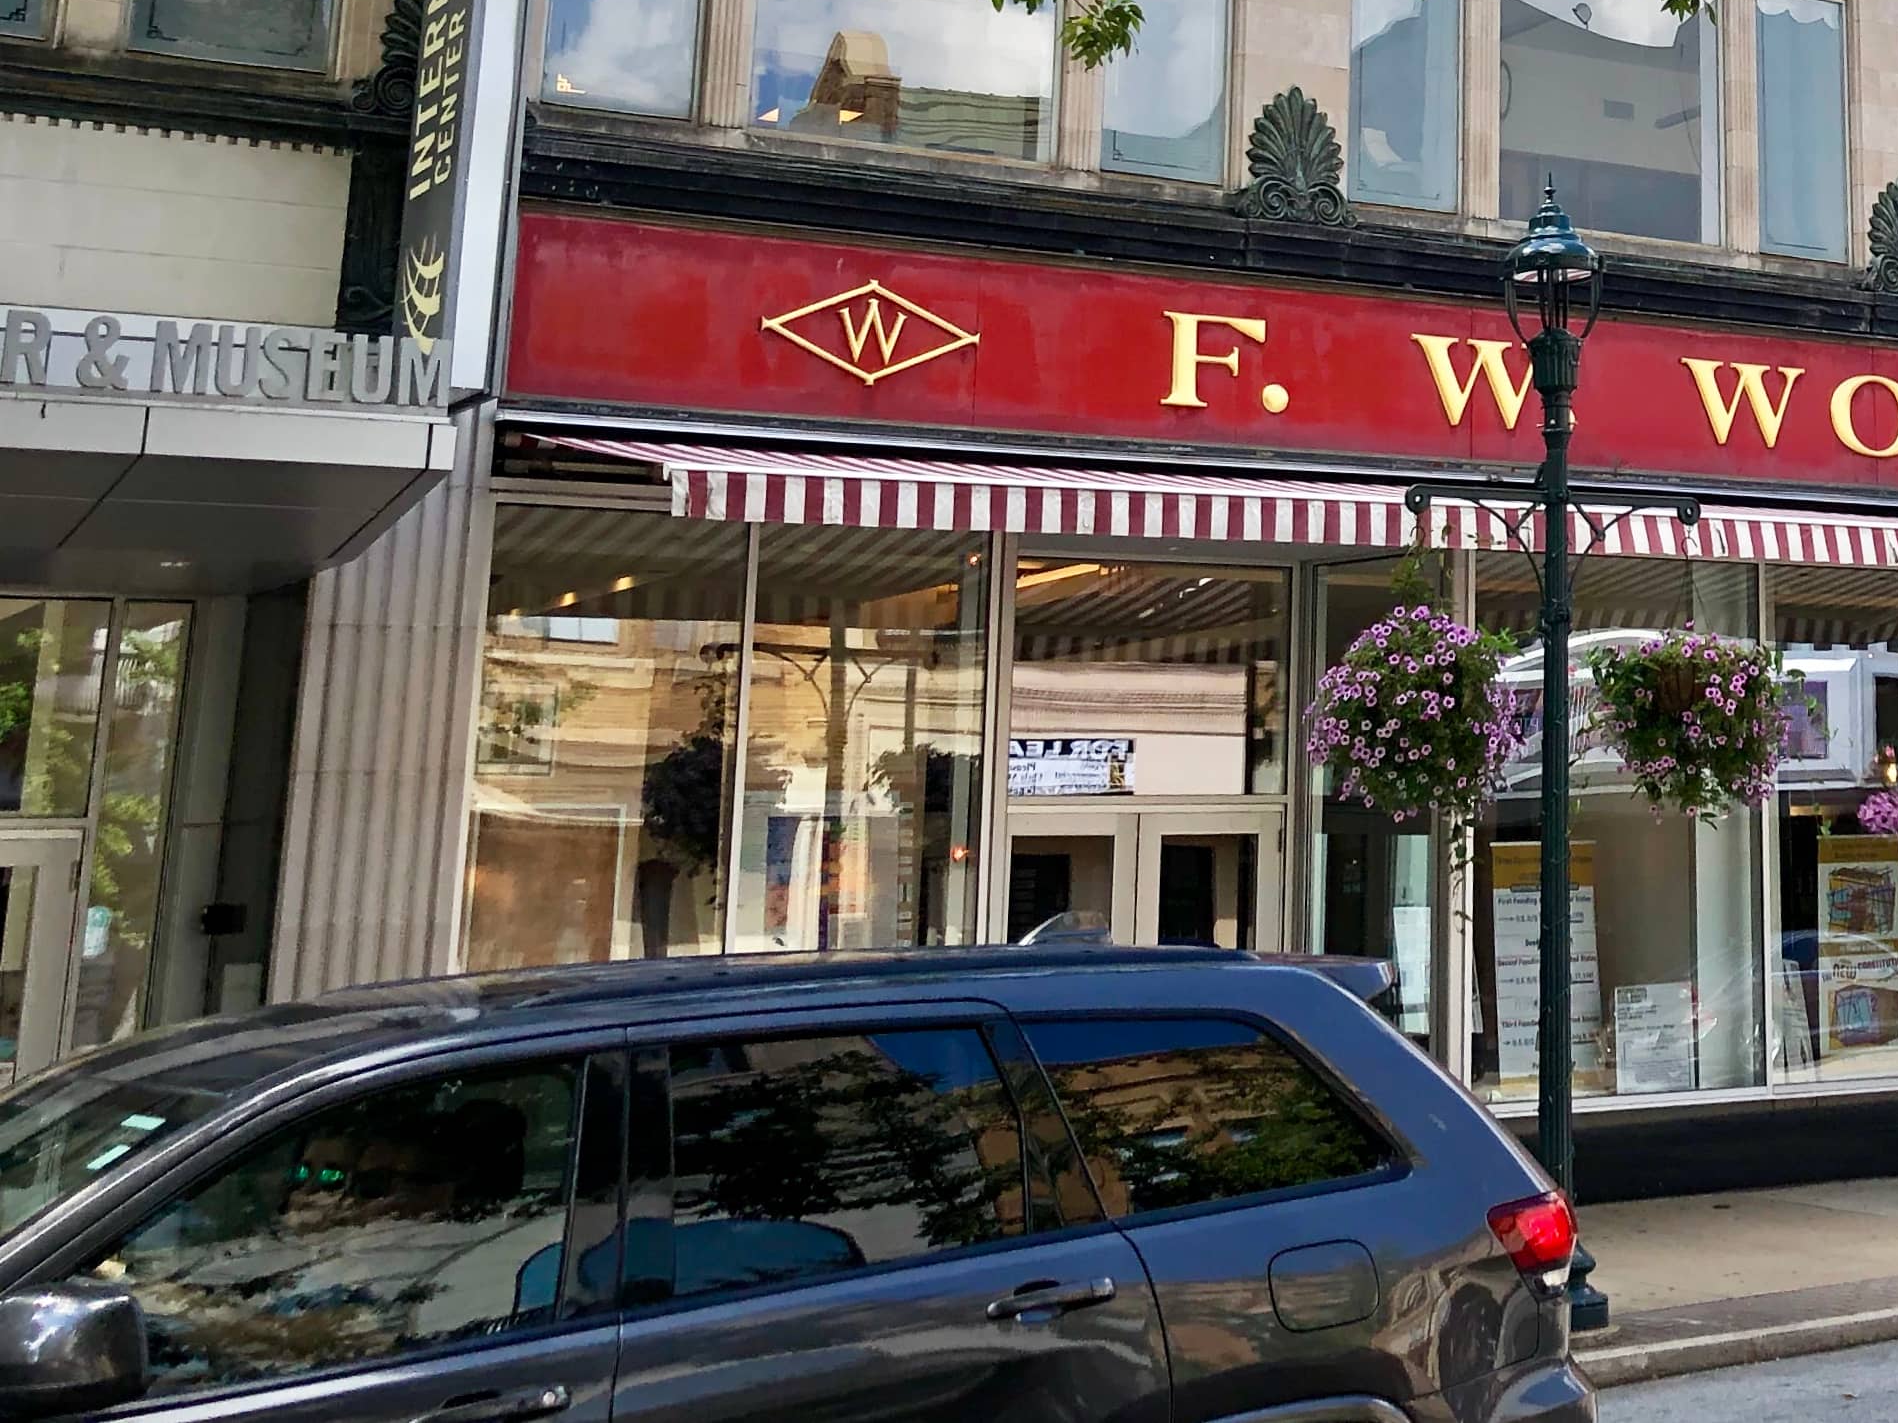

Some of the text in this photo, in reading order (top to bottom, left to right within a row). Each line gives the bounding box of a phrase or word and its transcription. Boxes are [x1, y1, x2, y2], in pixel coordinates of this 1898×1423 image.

[434, 8, 467, 186] CENTER
[75, 315, 131, 391] &
[149, 319, 451, 408] MUSEUM
[838, 297, 908, 366] W
[1159, 309, 1292, 415] F.
